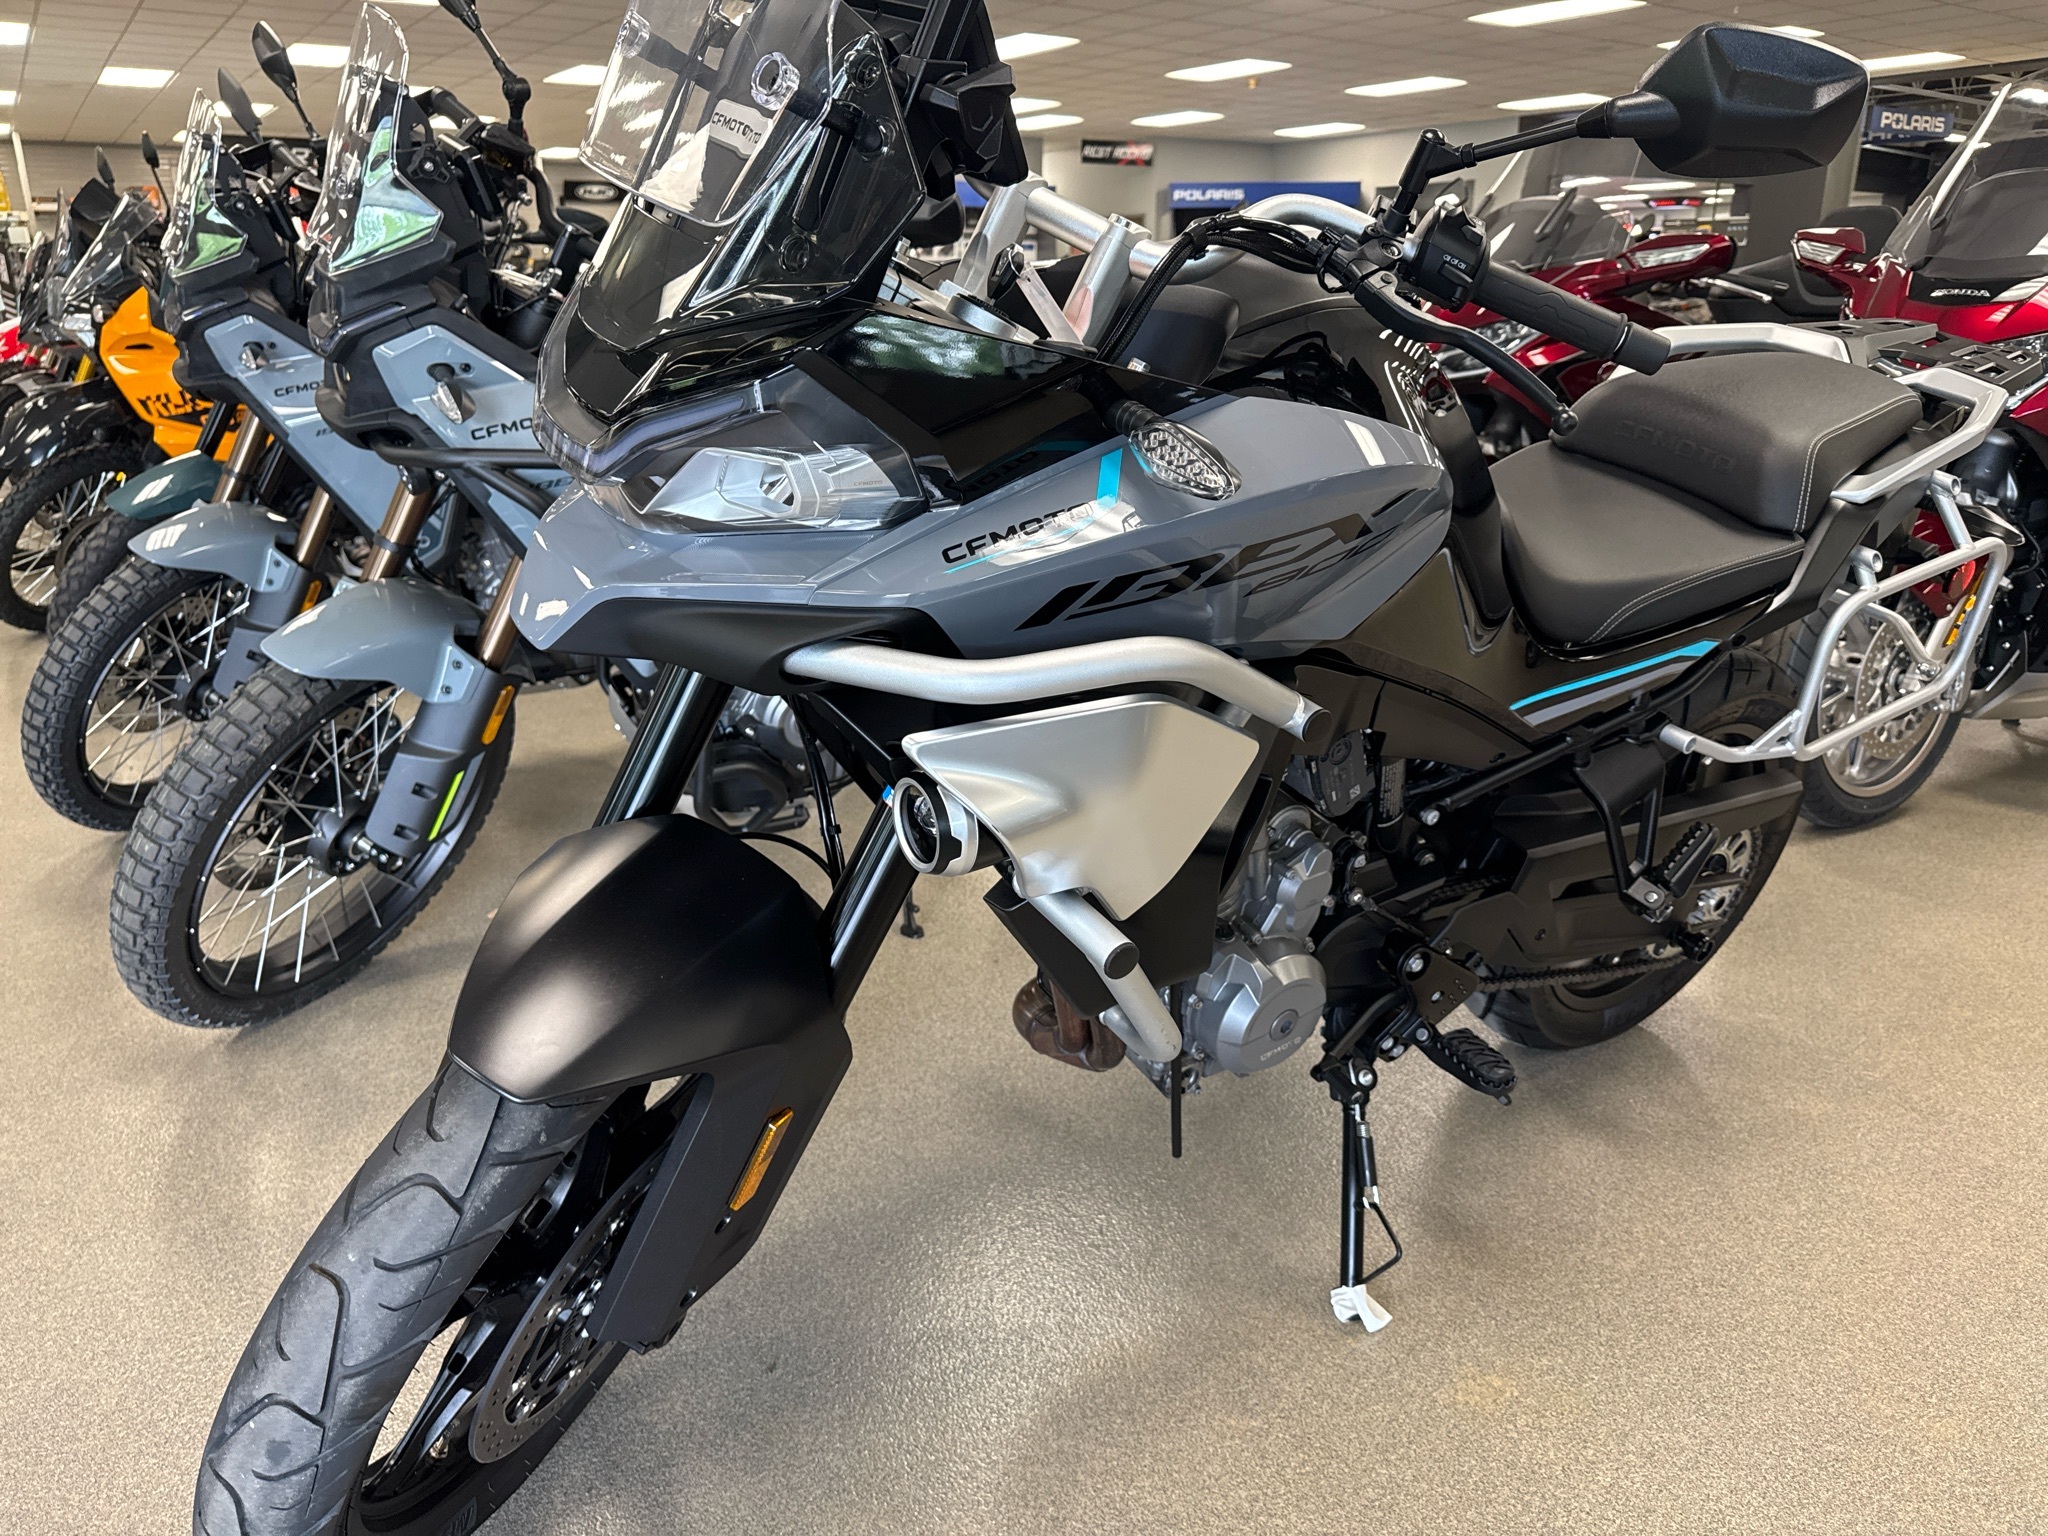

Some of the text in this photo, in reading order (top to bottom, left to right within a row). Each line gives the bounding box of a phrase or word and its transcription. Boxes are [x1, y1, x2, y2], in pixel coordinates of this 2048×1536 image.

[1880, 111, 1946, 133] POLARIS
[1173, 187, 1246, 201] POLARIS
[1930, 288, 1991, 297] HONDA
[274, 380, 324, 397] CFMO
